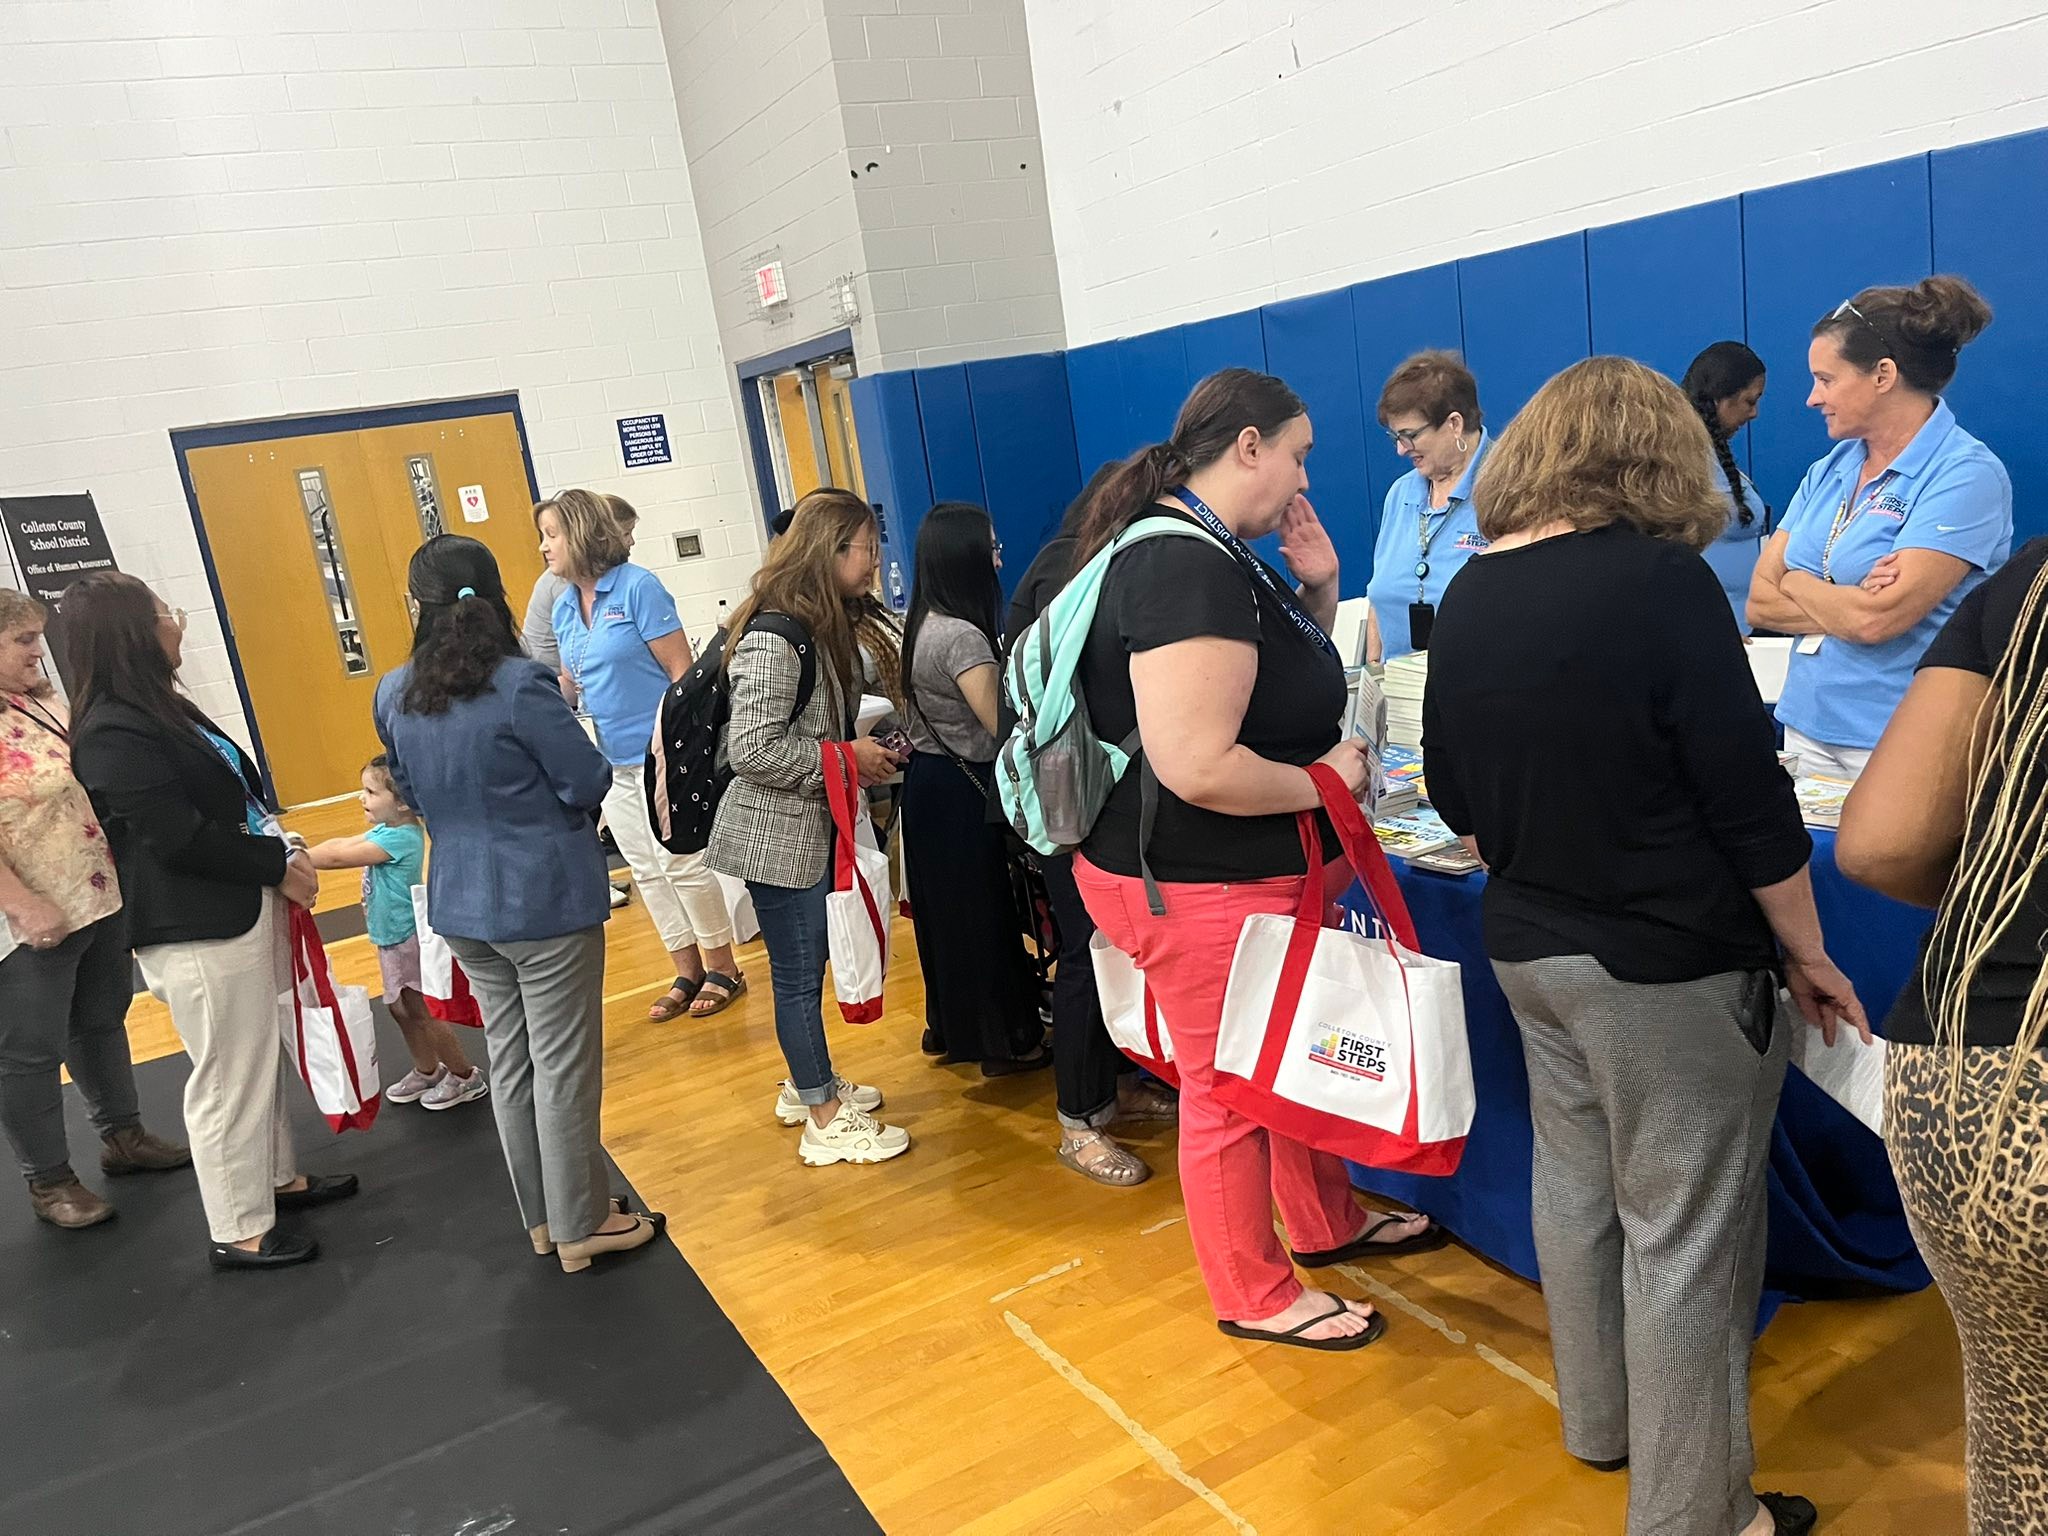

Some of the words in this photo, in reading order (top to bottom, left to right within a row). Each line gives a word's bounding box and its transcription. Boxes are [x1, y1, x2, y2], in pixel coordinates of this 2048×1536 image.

[622, 418, 651, 426] OCCUPANCY
[624, 438, 654, 446] DANGEROUS
[629, 431, 652, 439] PERSONS
[1882, 496, 1907, 509] FIRST
[21, 521, 57, 534] Colleton
[57, 520, 86, 532] County
[1194, 502, 1230, 540] DISTRICT
[30, 536, 59, 551] School
[60, 535, 90, 548] District
[27, 564, 46, 575] Office
[47, 562, 55, 573] of
[54, 562, 79, 572] Human
[78, 559, 112, 569] Resources
[1318, 1021, 1357, 1038] COLLETON
[1359, 1034, 1392, 1048] COUNTY
[1340, 1036, 1384, 1058] FIRST
[1337, 1049, 1386, 1073] STEPS
